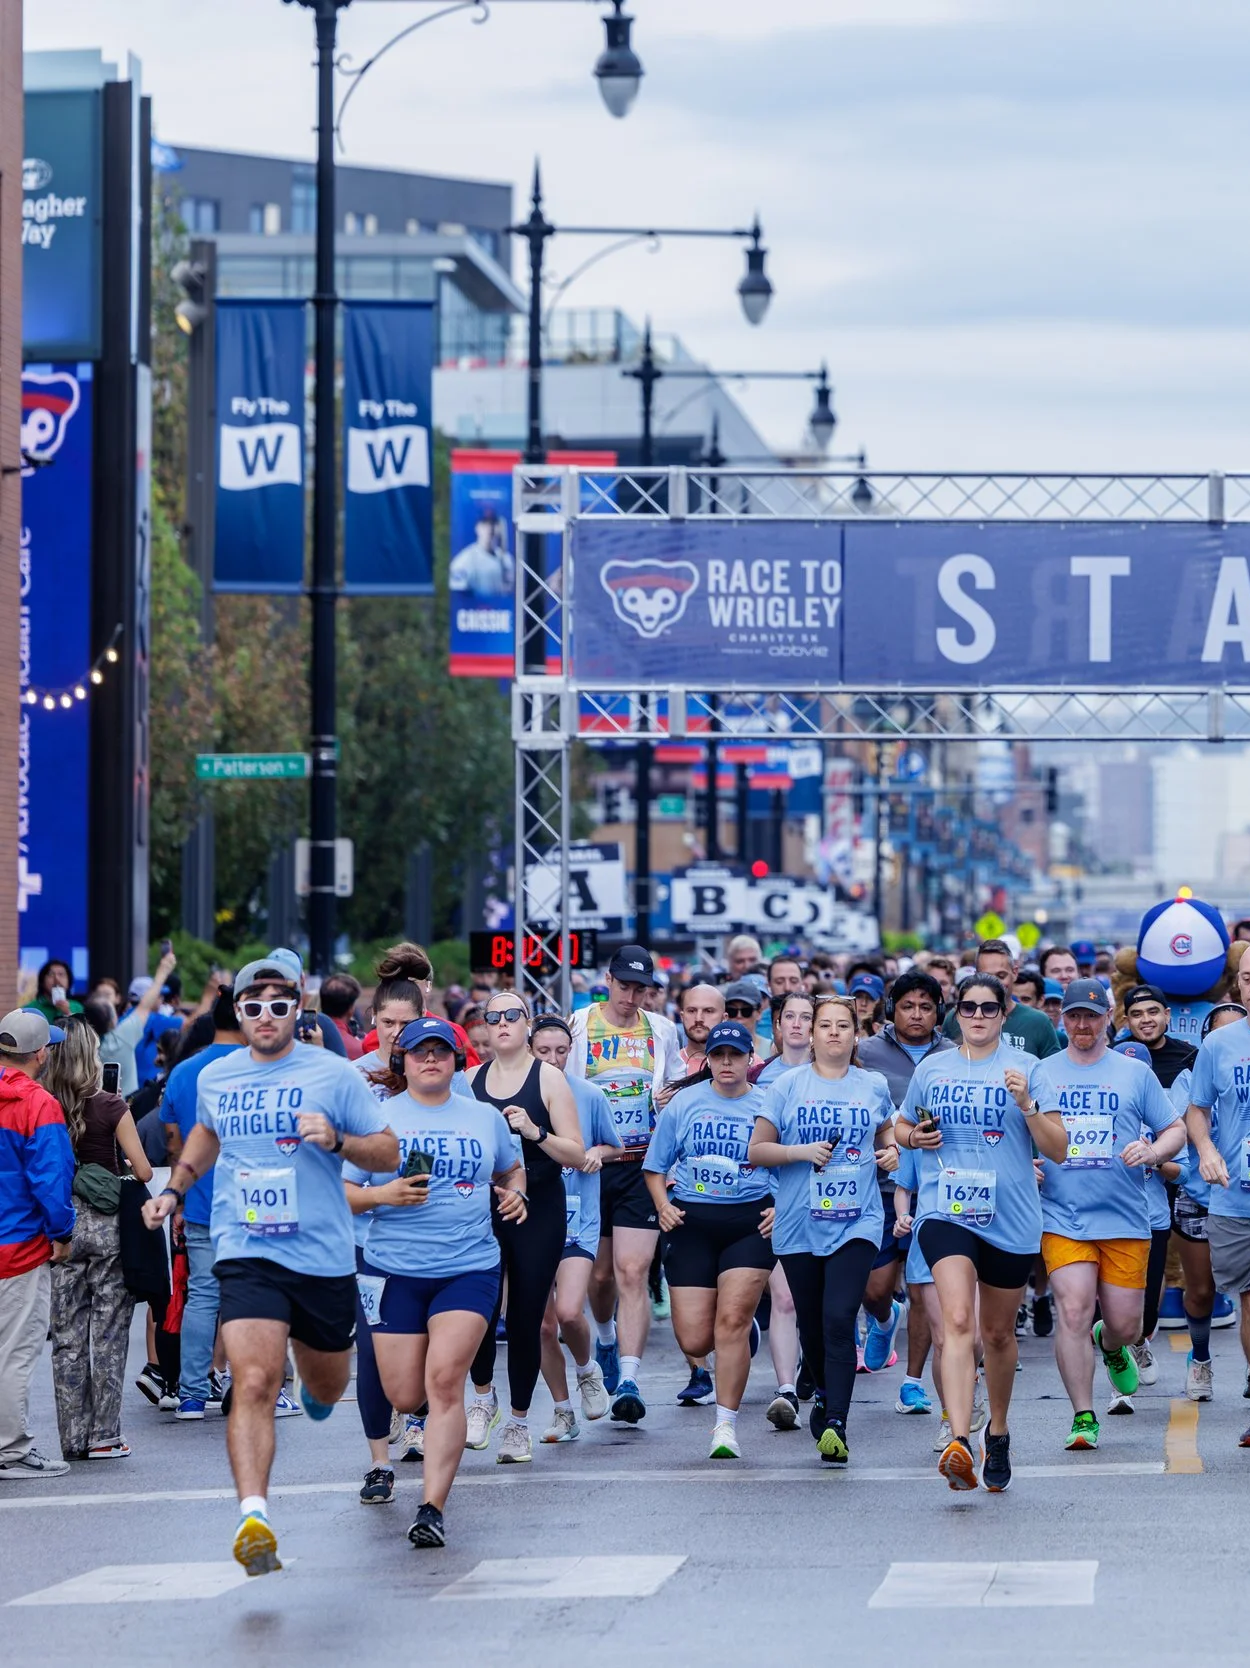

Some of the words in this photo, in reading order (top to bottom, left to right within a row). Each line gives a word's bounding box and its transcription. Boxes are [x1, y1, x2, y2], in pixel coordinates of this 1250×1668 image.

[231, 397, 257, 417] Fly
[258, 397, 290, 415] The
[358, 400, 384, 420] Fly
[385, 400, 418, 417] The
[238, 435, 283, 477] W
[366, 437, 411, 479] W
[708, 560, 790, 594] RACE
[801, 560, 842, 594] TO
[708, 597, 841, 628] WRIGLEY
[729, 633, 795, 643] CHARITY
[213, 758, 285, 776] Patterson
[556, 870, 598, 911] A
[692, 886, 727, 916] B
[763, 894, 788, 920] C
[1169, 1017, 1198, 1033] LAR
[1014, 1036, 1025, 1046] TO
[627, 1049, 645, 1058] ON
[217, 1090, 268, 1115] RACE
[277, 1088, 303, 1108] TO
[931, 1086, 976, 1106] RACE
[984, 1087, 1007, 1106] TO
[1058, 1092, 1091, 1109] ACE
[1098, 1092, 1119, 1111] TO
[217, 1112, 298, 1138] WRIGLEY
[797, 1106, 841, 1126] RACE
[849, 1107, 870, 1127] TO
[693, 1122, 738, 1141] RACE
[1067, 1130, 1109, 1145] 1697
[398, 1138, 447, 1158] RACE
[456, 1138, 482, 1159] TO
[398, 1159, 481, 1180] WGLEY
[692, 1167, 734, 1186] 1856
[241, 1189, 288, 1207] 1401
[697, 1184, 704, 1192] C
[816, 1180, 857, 1197] 1673
[945, 1184, 990, 1201] 1674
[359, 1294, 373, 1310] 36
